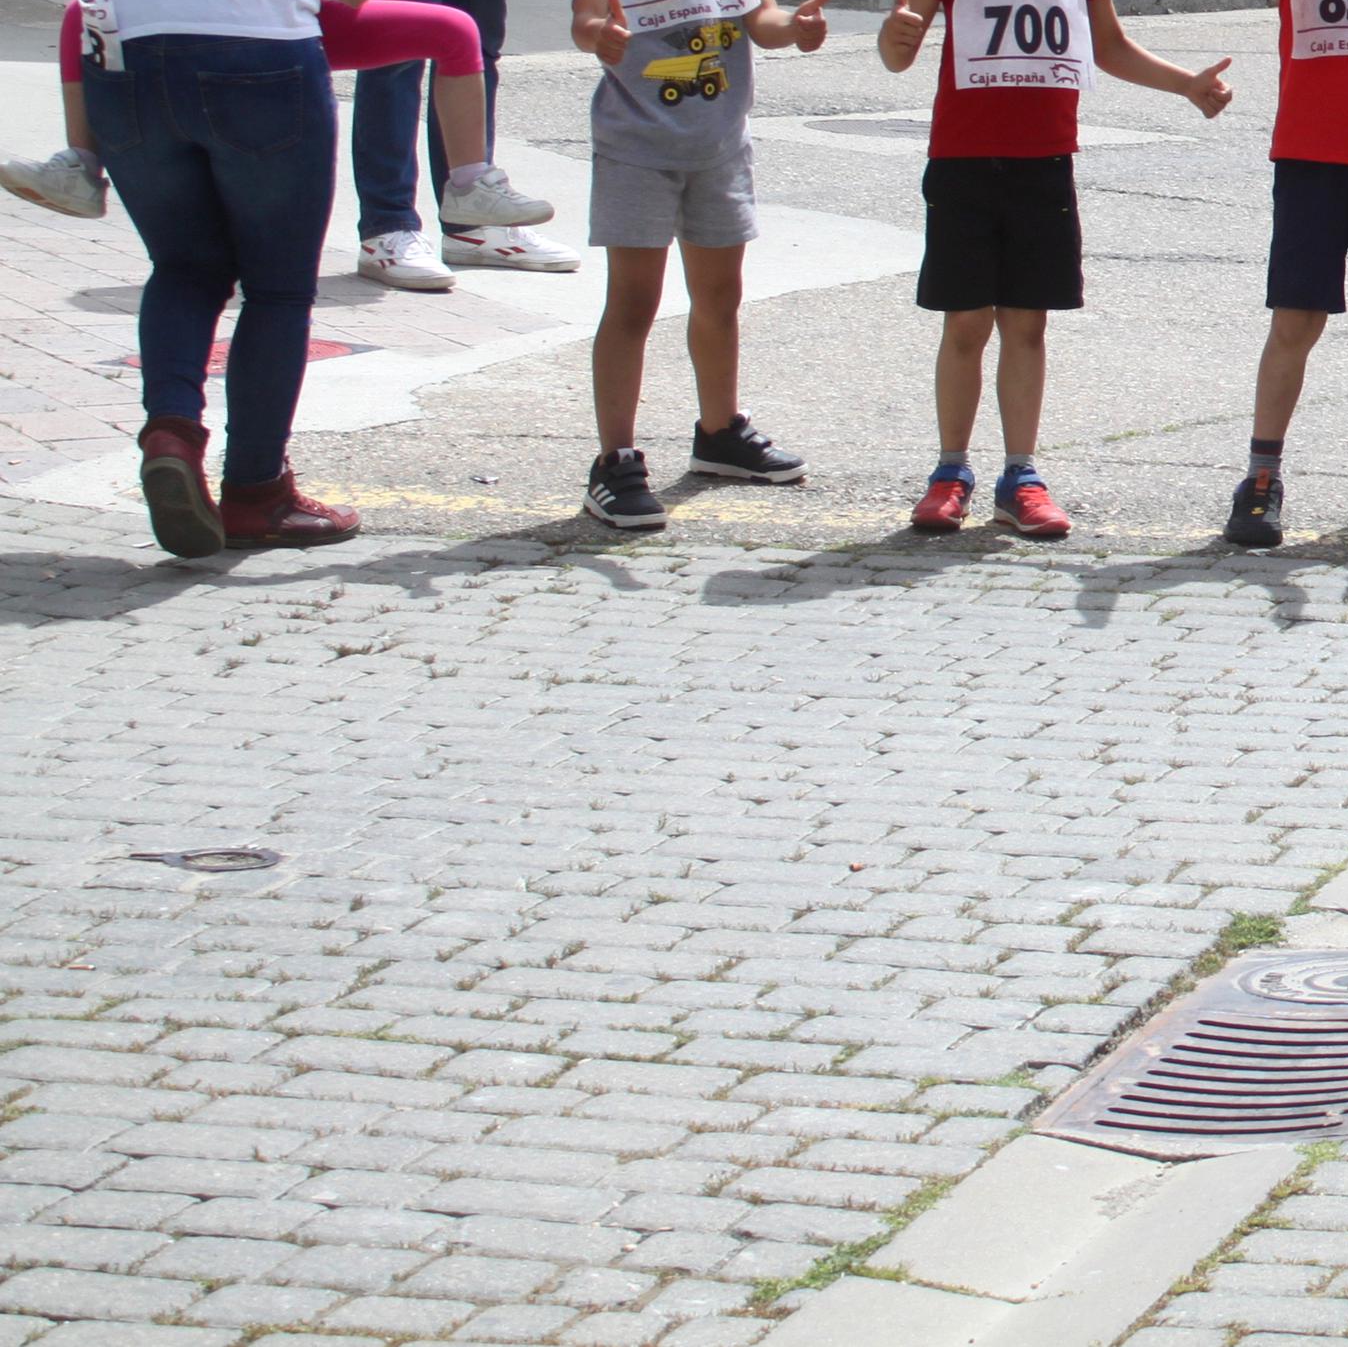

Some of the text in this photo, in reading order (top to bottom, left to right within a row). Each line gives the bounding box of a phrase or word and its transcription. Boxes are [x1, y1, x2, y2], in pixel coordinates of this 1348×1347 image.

[637, 4, 713, 28] Caja España
[984, 4, 1070, 56] 700
[1310, 40, 1334, 54] Caja
[968, 71, 1046, 87] Caja España
